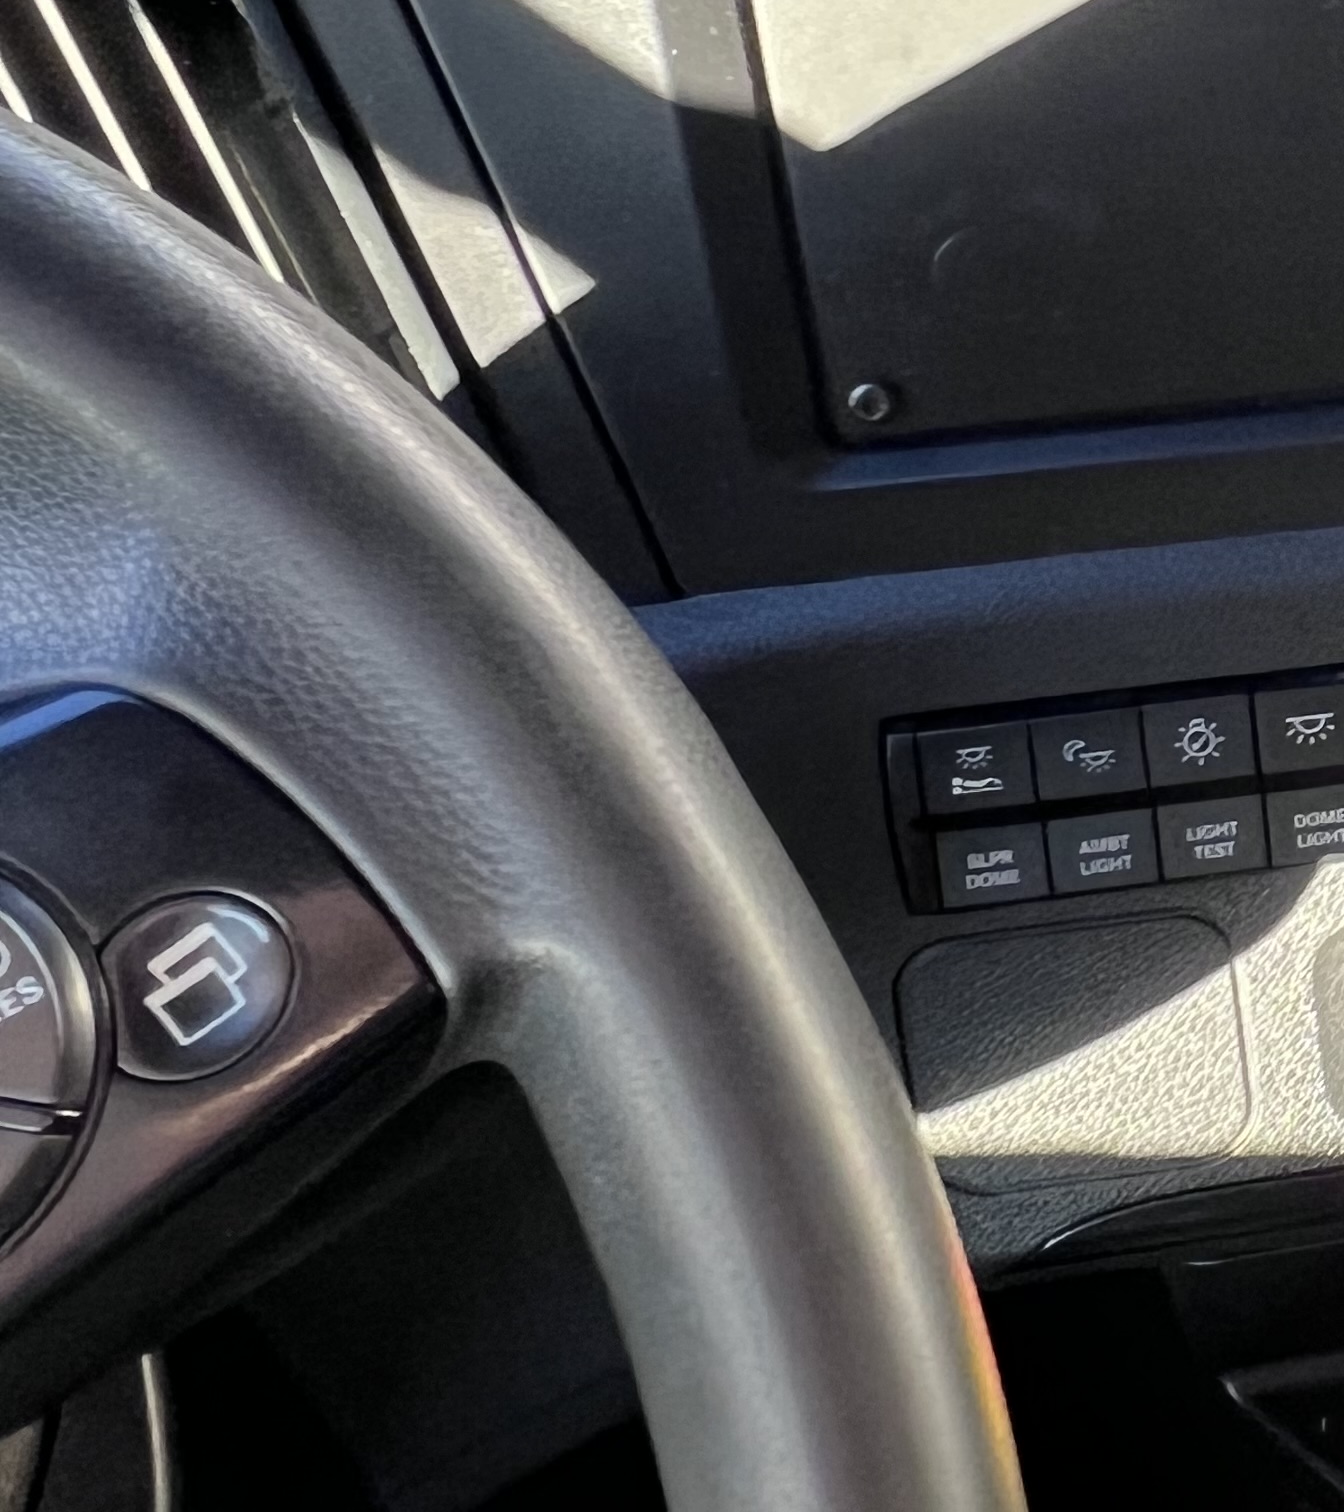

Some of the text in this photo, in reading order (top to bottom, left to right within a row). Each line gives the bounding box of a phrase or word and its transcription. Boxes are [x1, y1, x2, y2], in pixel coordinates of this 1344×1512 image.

[1185, 820, 1239, 842] LIGHT
[1193, 841, 1236, 860] TEST
[1079, 854, 1133, 876] LIGHT
